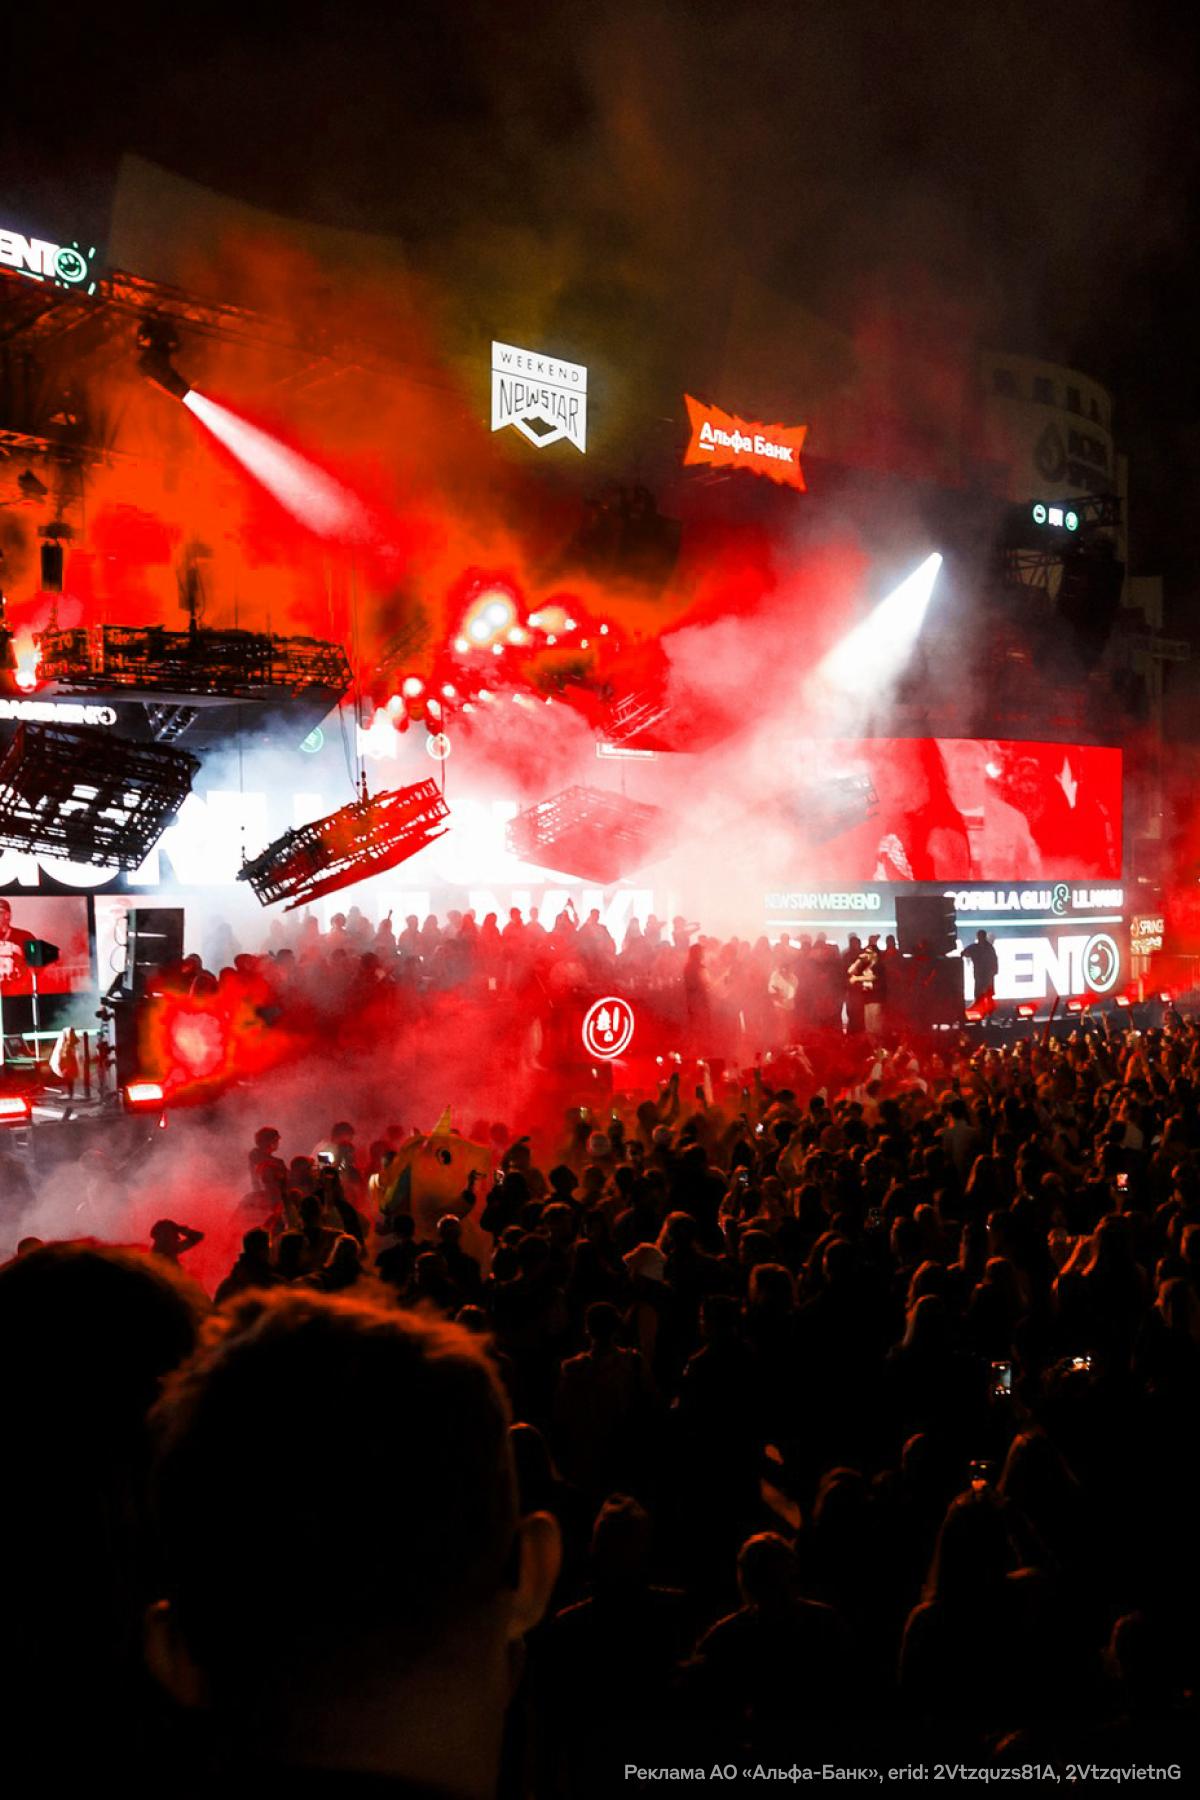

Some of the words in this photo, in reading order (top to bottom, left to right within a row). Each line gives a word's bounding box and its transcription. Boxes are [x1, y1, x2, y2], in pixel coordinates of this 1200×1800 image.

[501, 351, 579, 382] WEEKEND
[700, 421, 753, 454] Альфа
[753, 434, 794, 463] Банк
[818, 892, 881, 910] WEEKEND
